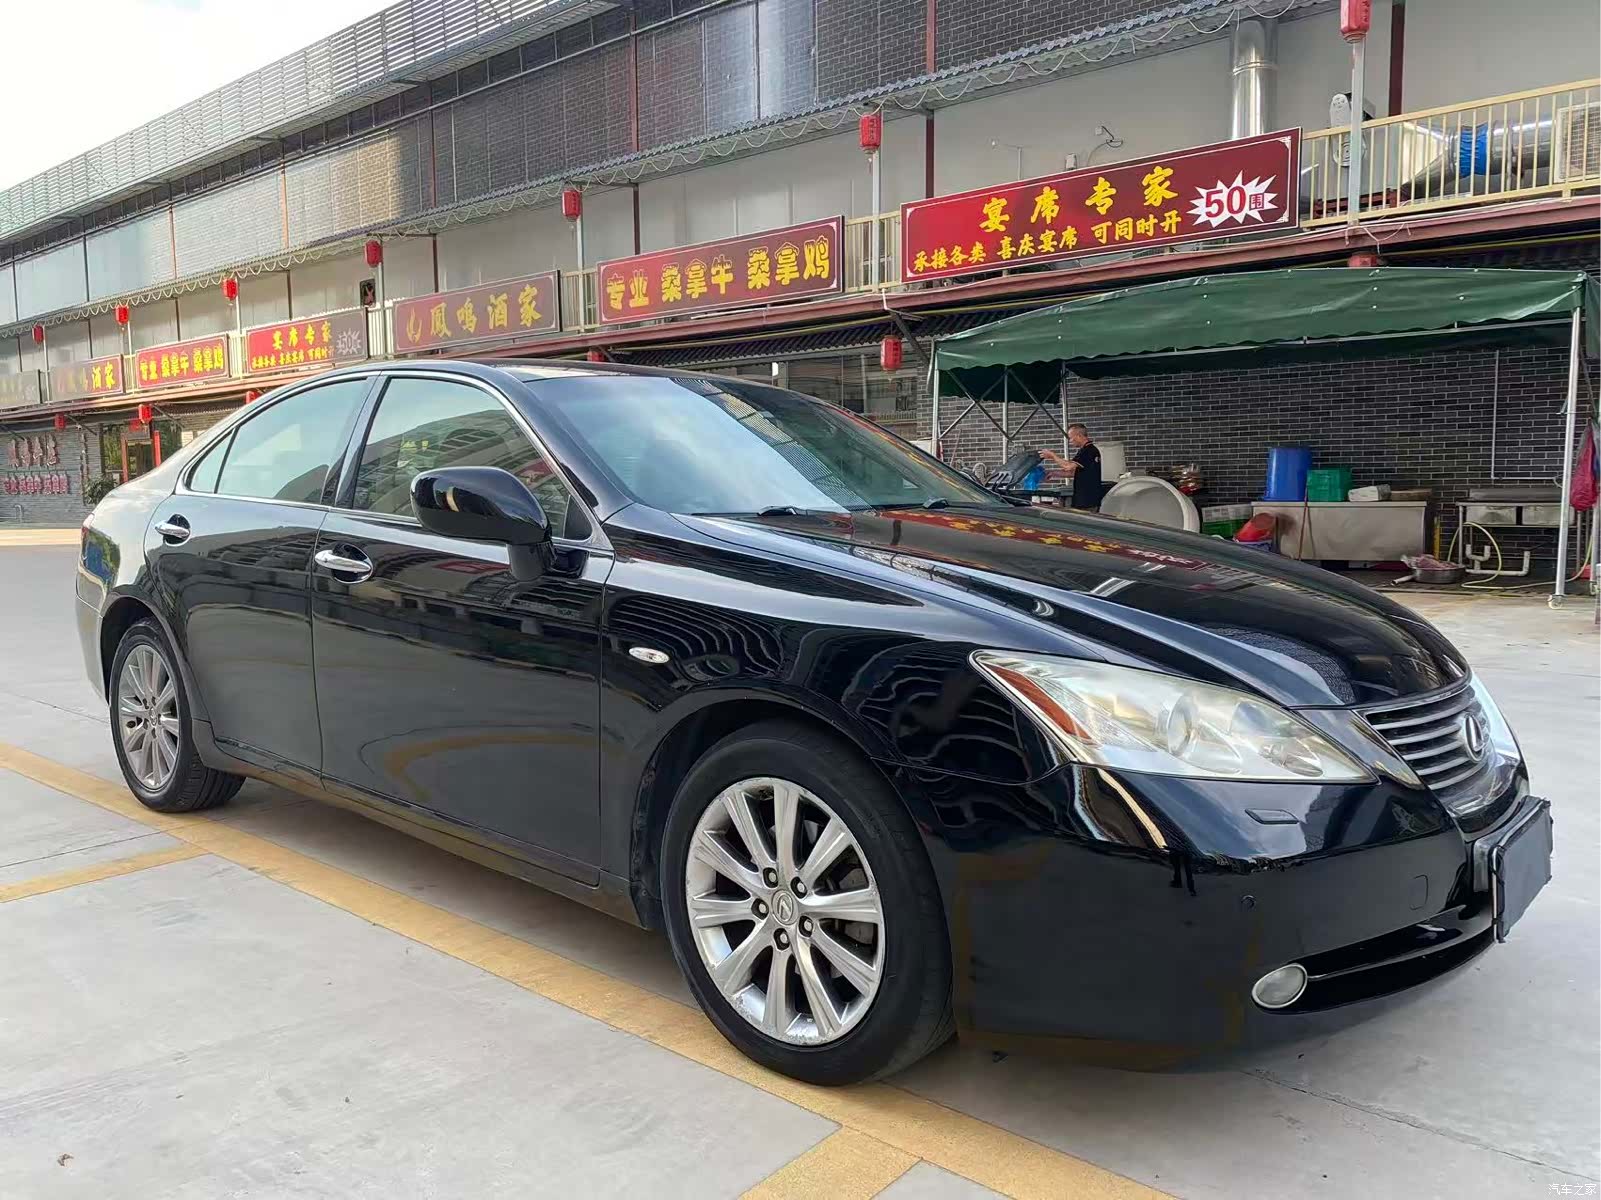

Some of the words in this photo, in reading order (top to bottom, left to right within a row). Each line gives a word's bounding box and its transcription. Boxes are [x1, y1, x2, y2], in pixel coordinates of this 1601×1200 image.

[979, 166, 1179, 233] 宴席专家
[606, 272, 650, 311] 专业
[661, 254, 734, 303] 桑拿牛
[747, 235, 830, 290] 桑拿鸡
[914, 241, 987, 273] 承接各类
[997, 225, 1078, 260] 喜庆宴席
[1091, 210, 1182, 245] 可同时开
